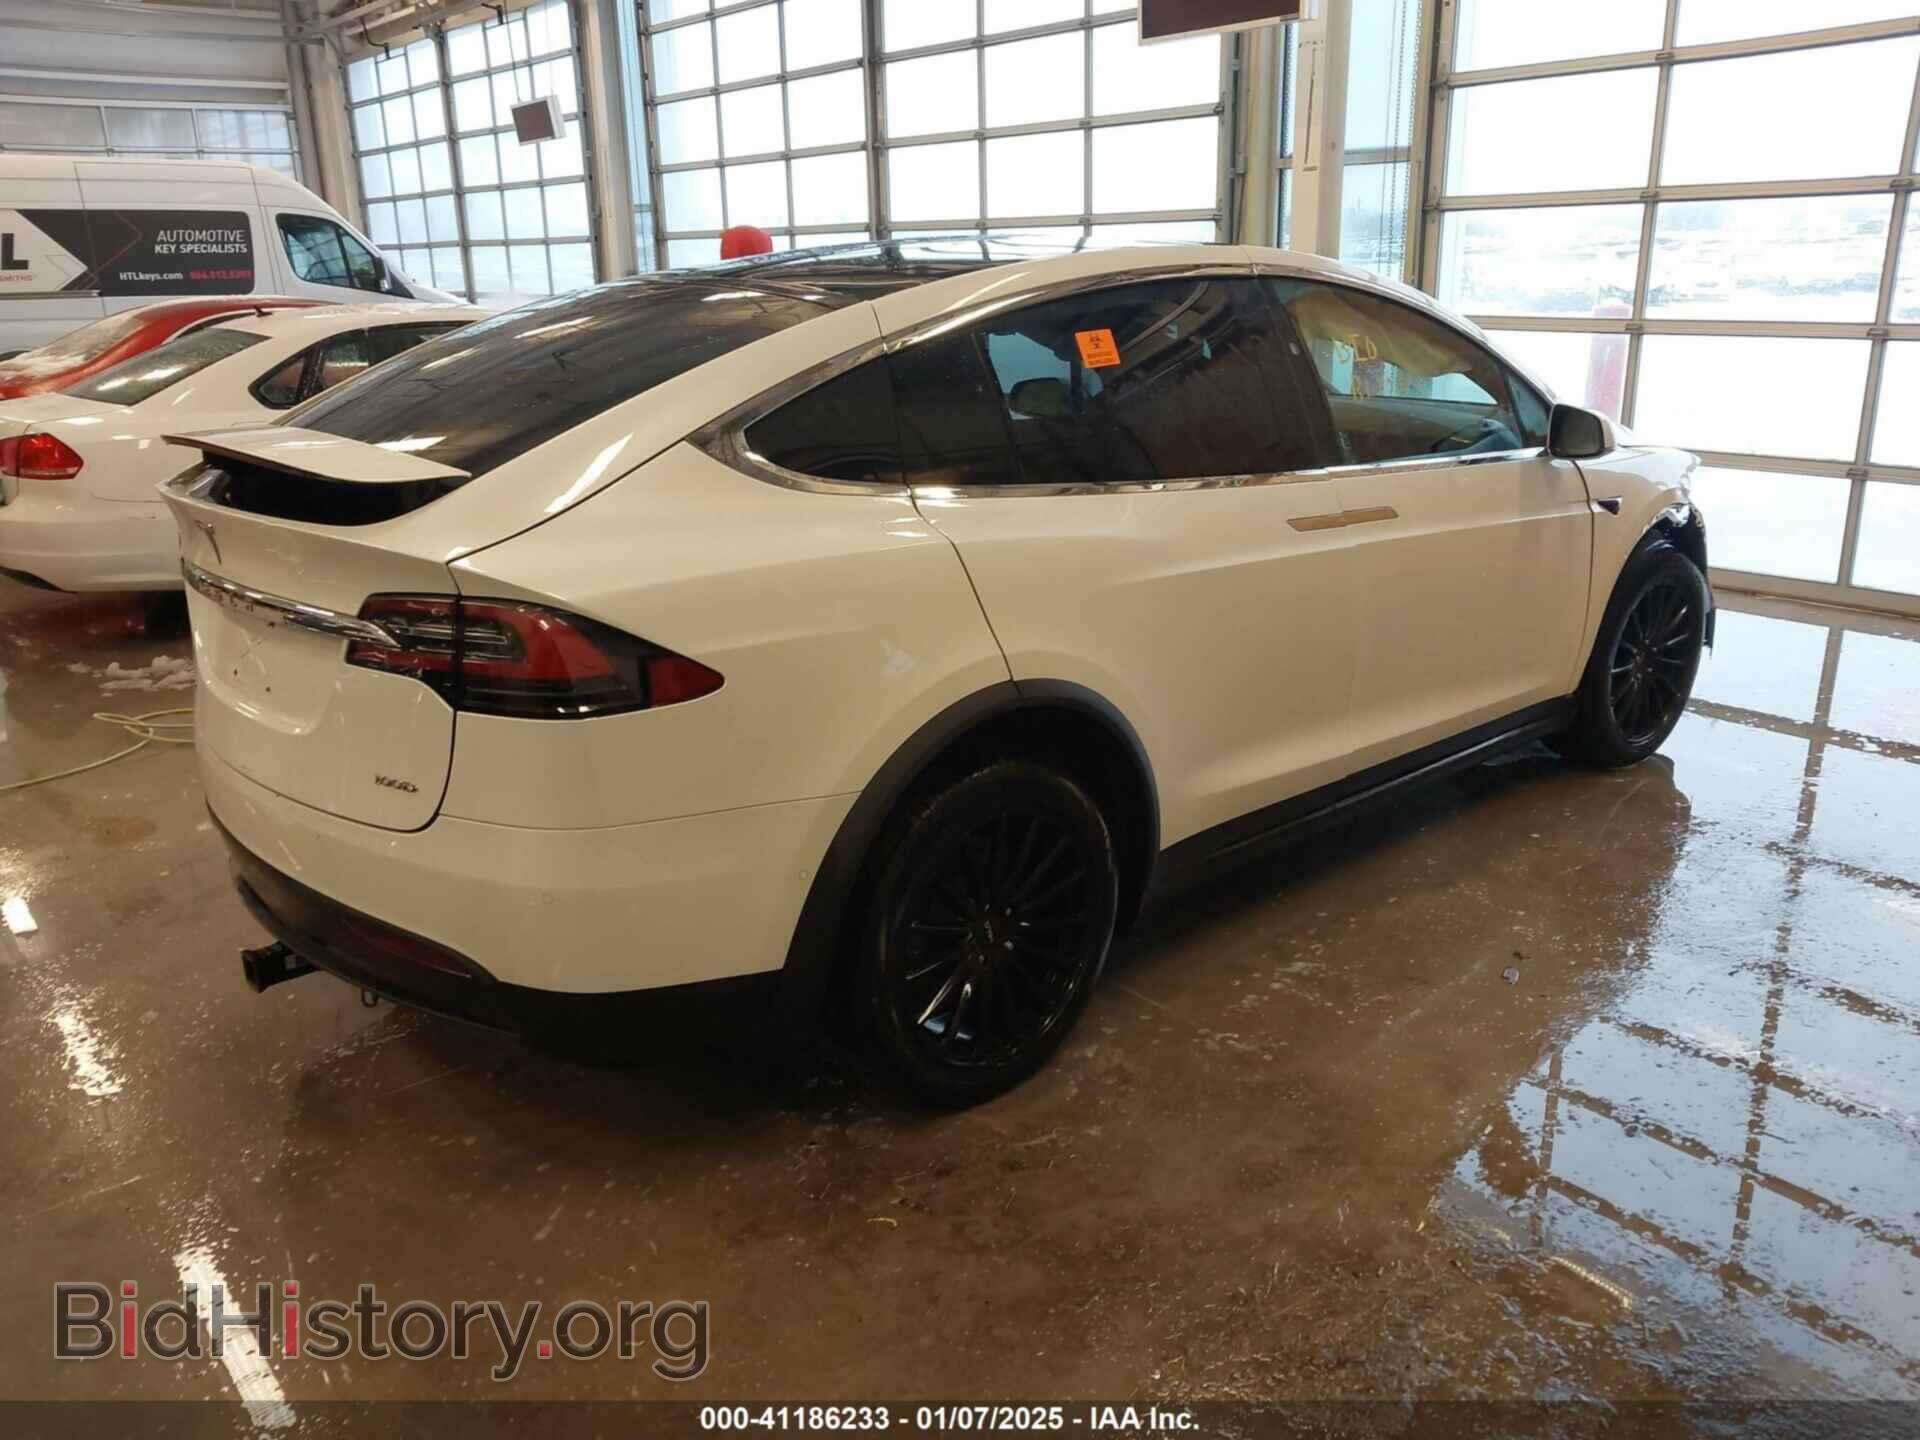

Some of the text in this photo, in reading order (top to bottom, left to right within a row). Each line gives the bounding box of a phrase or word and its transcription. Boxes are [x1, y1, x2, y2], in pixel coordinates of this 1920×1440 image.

[156, 229, 246, 242] AUTOMOTIVE
[154, 243, 248, 254] KEY SPECIALISTS
[119, 271, 184, 282] HTLkeys.com
